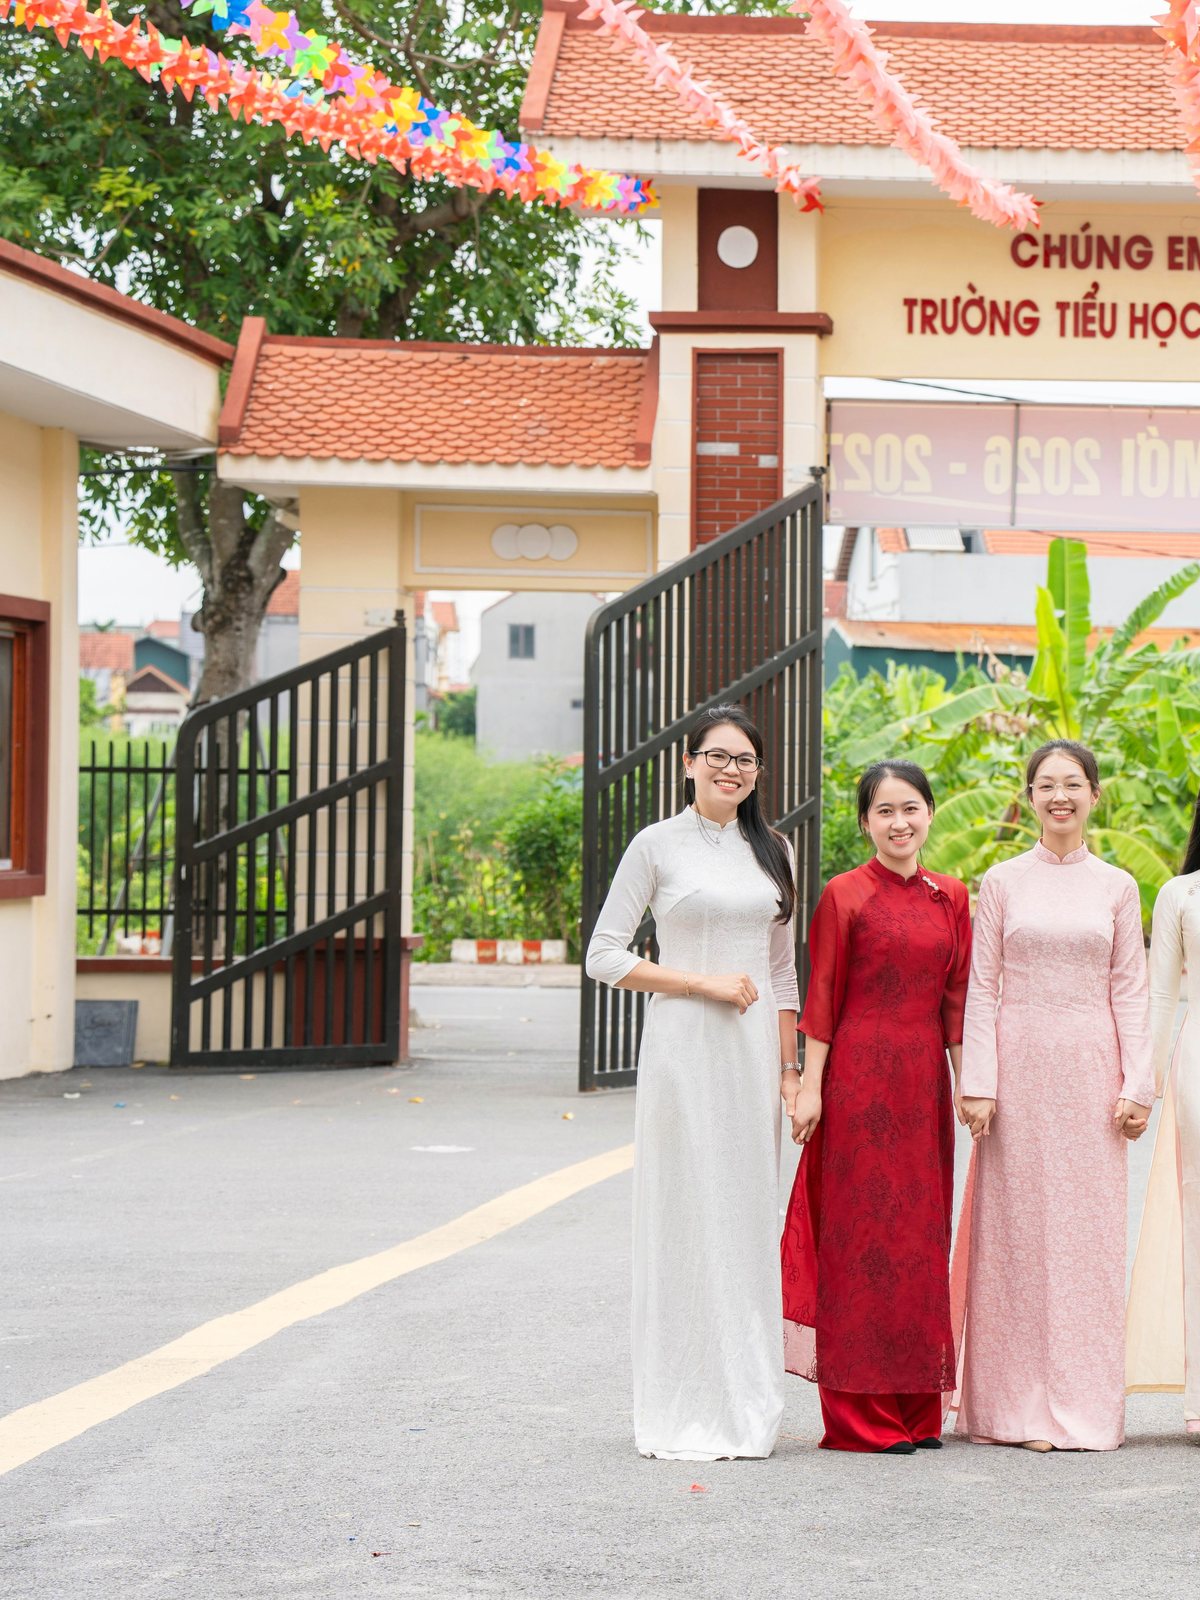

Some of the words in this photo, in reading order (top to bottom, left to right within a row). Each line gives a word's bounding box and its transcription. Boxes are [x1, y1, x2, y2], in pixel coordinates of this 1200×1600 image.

[1010, 221, 1155, 271] CHÚNG
[903, 282, 1041, 337] TRƯỜNG
[1055, 281, 1118, 339] TIỂU
